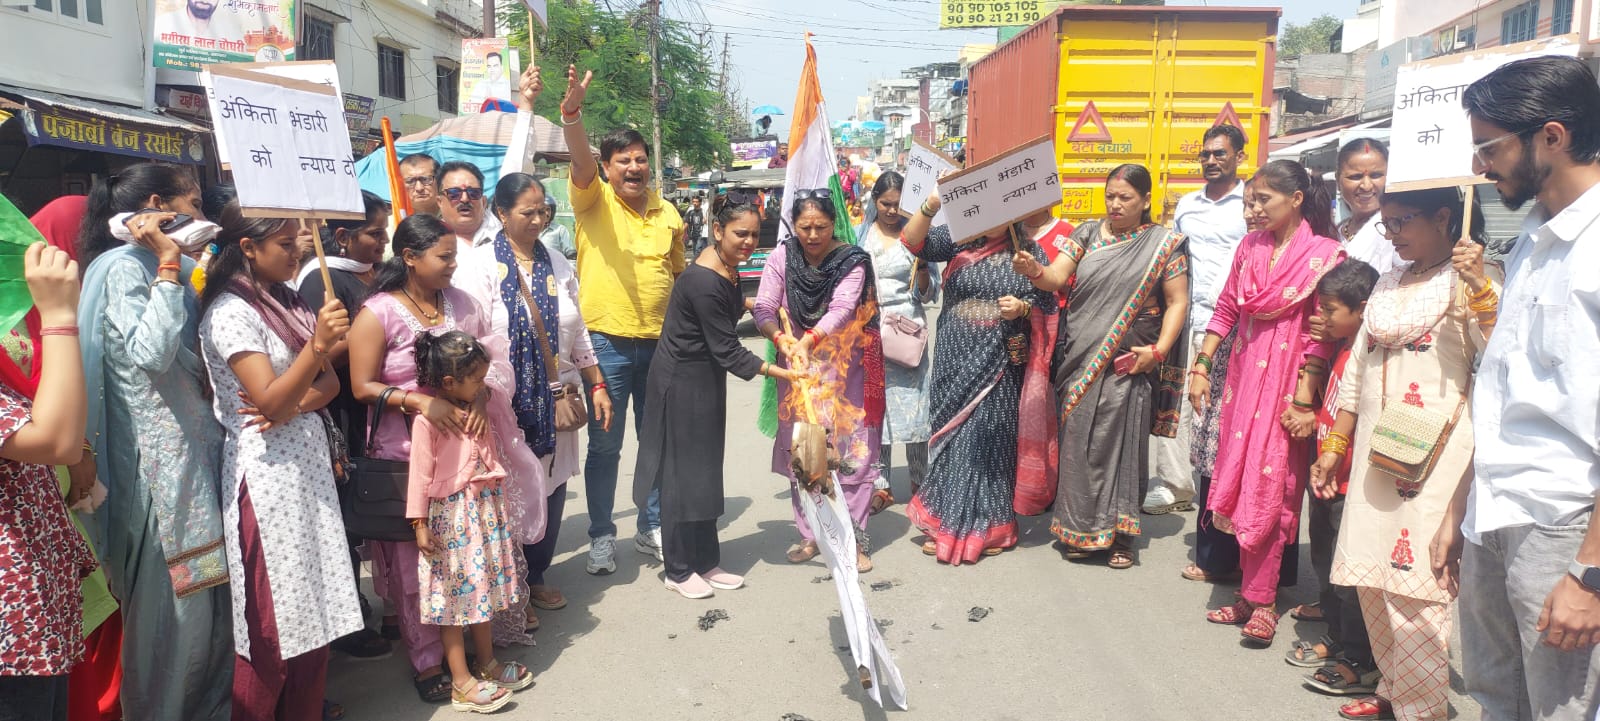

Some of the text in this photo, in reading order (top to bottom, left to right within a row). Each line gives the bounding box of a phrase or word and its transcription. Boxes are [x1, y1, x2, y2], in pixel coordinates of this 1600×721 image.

[948, 4, 964, 13] 90
[1016, 1, 1038, 11] 105
[948, 15, 964, 24] 90
[968, 14, 985, 23] 90
[1006, 13, 1019, 22] 21
[1023, 12, 1040, 22] 90
[194, 36, 216, 49] लाल
[1396, 83, 1470, 110] अंकिता
[219, 95, 278, 125] अंकिता
[289, 106, 328, 133] भंडारी
[1416, 123, 1445, 146] को
[1097, 139, 1133, 154] बचाओ
[250, 144, 357, 179] को न्याय दो
[908, 155, 933, 175] अंकिता
[912, 182, 922, 197] को
[942, 158, 1036, 205] अंकिता भंडारी
[962, 172, 1060, 219] को न्याय दो
